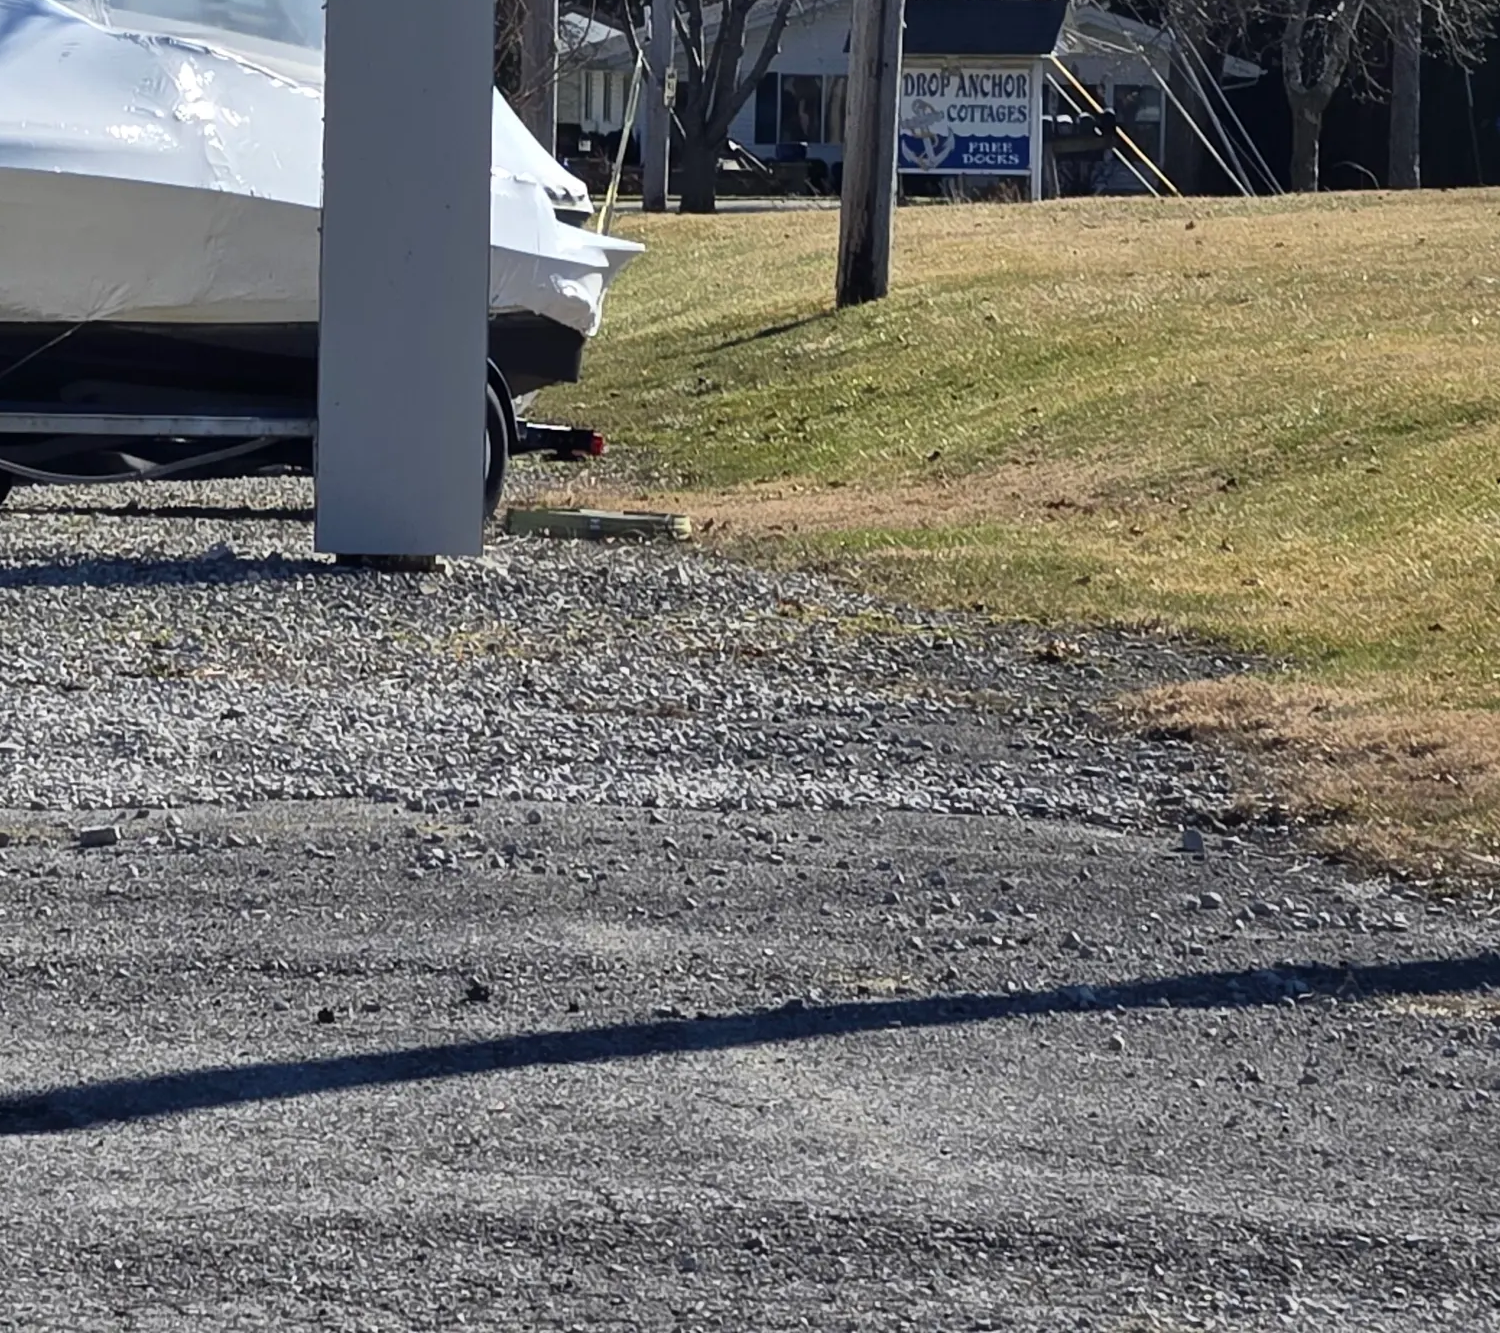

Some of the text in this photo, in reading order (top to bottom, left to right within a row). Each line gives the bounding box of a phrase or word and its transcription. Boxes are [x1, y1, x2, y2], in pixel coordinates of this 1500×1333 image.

[903, 72, 1027, 99] DROP ANCHOR
[947, 104, 1027, 124] COTTAGES
[968, 141, 1013, 154] FREE
[962, 153, 1020, 165] DOCKS
